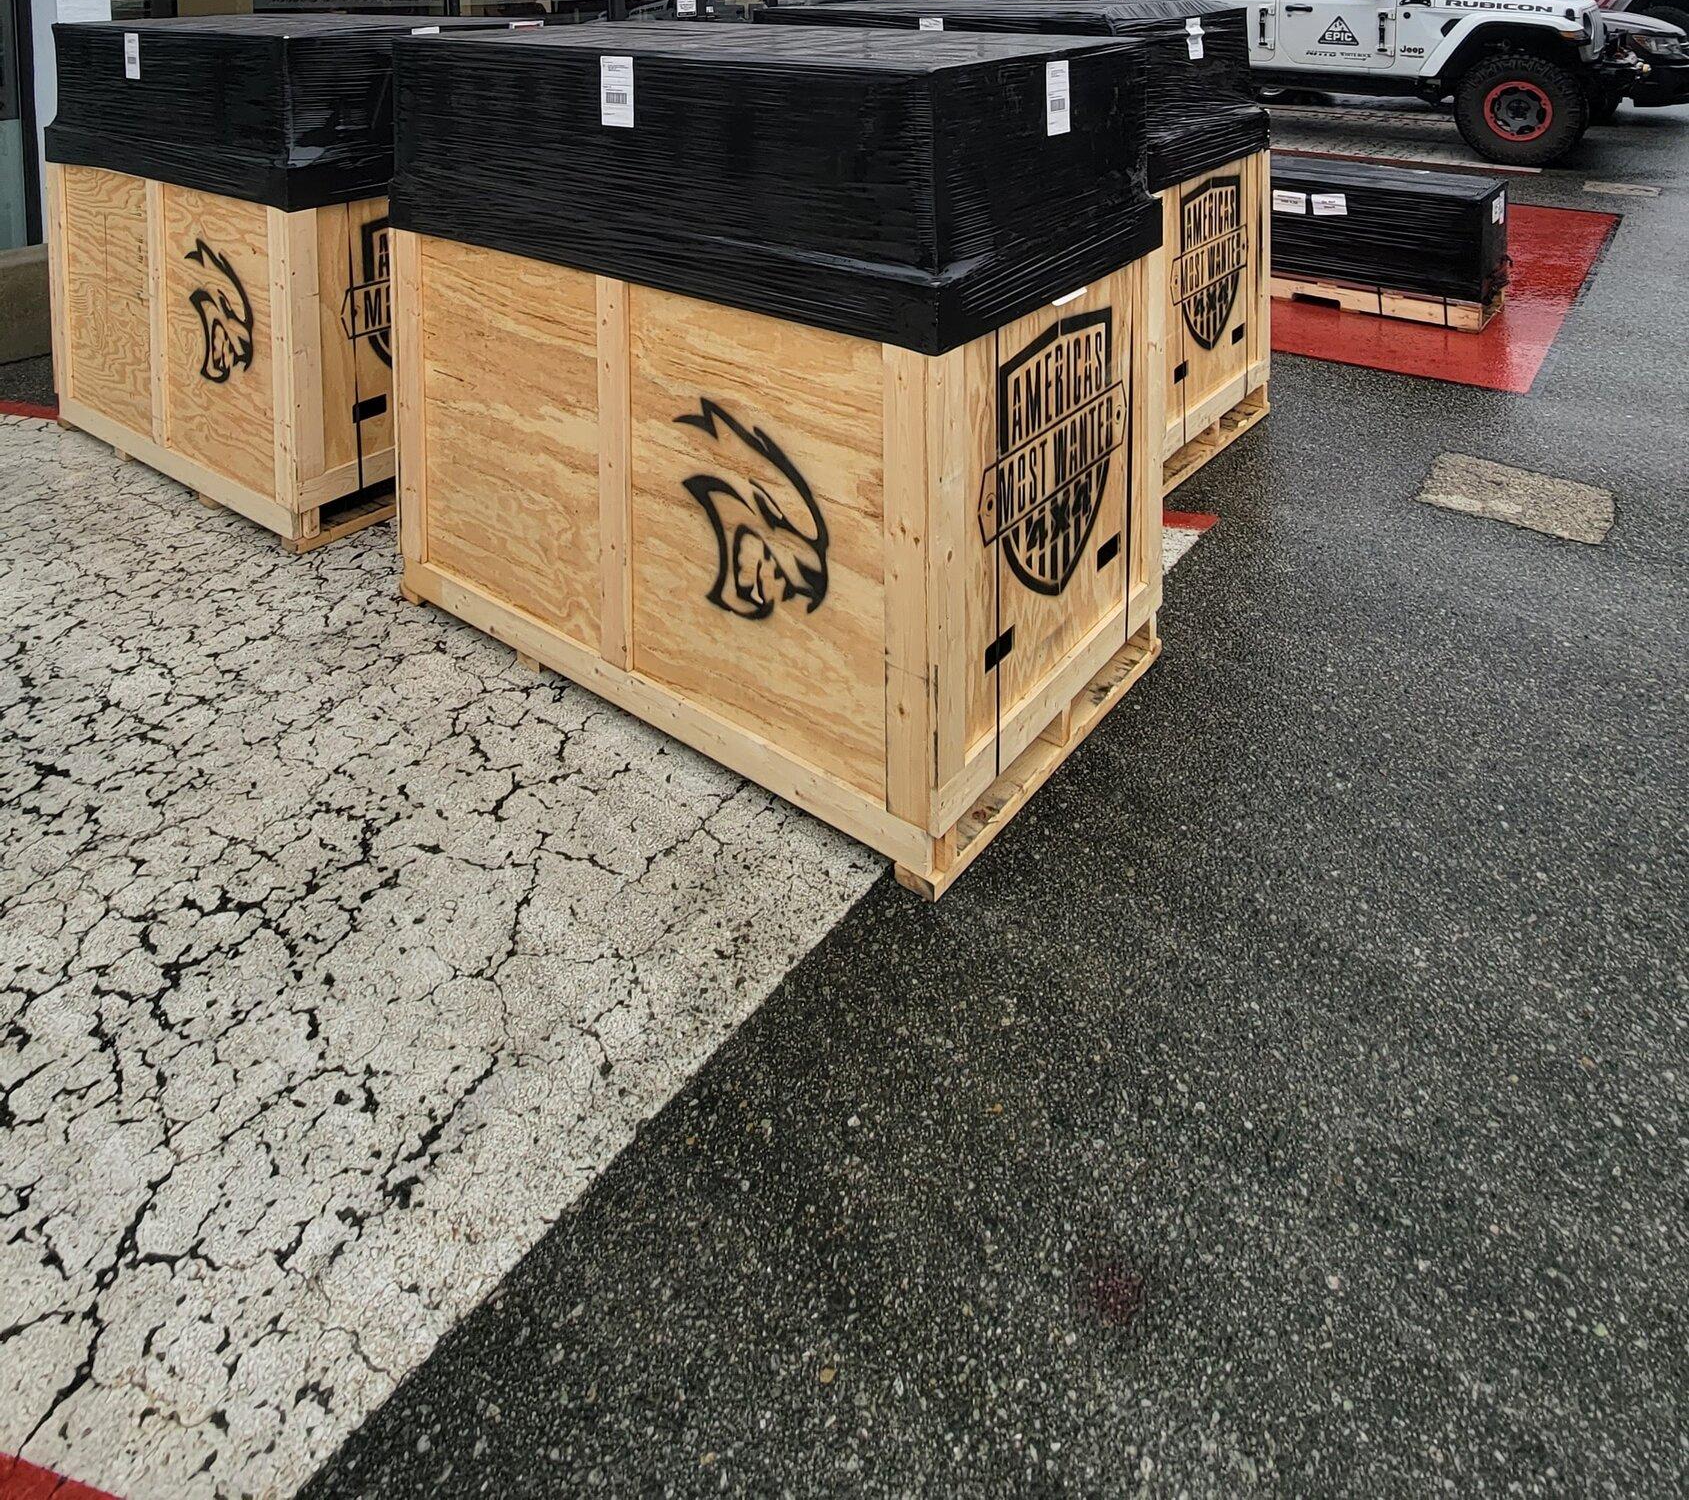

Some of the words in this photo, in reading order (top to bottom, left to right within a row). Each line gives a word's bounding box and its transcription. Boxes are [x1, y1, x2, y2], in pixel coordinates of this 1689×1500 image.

[1325, 31, 1353, 41] EPIC
[1445, 0, 1553, 13] RUBICON
[1400, 45, 1424, 54] Jeep
[1187, 189, 1235, 249] AMERICAS
[1182, 251, 1204, 293] MOST
[1208, 232, 1240, 280] WANTED
[1012, 331, 1102, 445] AMERICAS
[1000, 438, 1048, 523] MOST
[1054, 396, 1113, 486] WANTED
